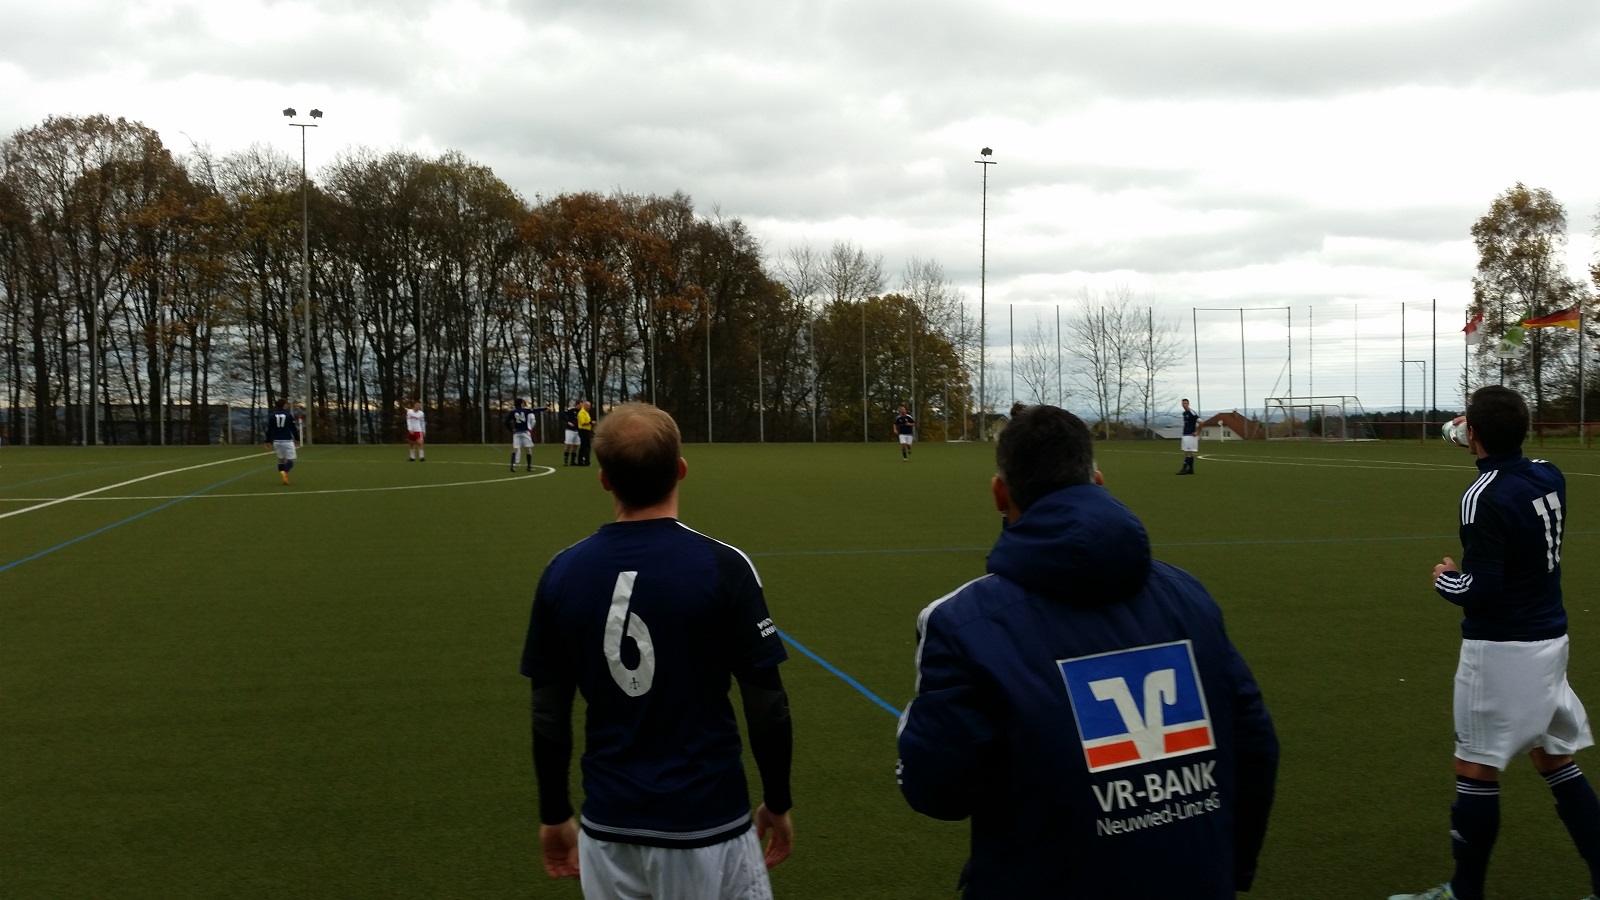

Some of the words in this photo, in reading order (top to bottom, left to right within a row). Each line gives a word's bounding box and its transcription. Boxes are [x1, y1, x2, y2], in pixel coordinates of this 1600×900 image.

[1531, 491, 1563, 574] 11
[603, 570, 655, 697] 6
[1091, 760, 1218, 813] VR-BANK
